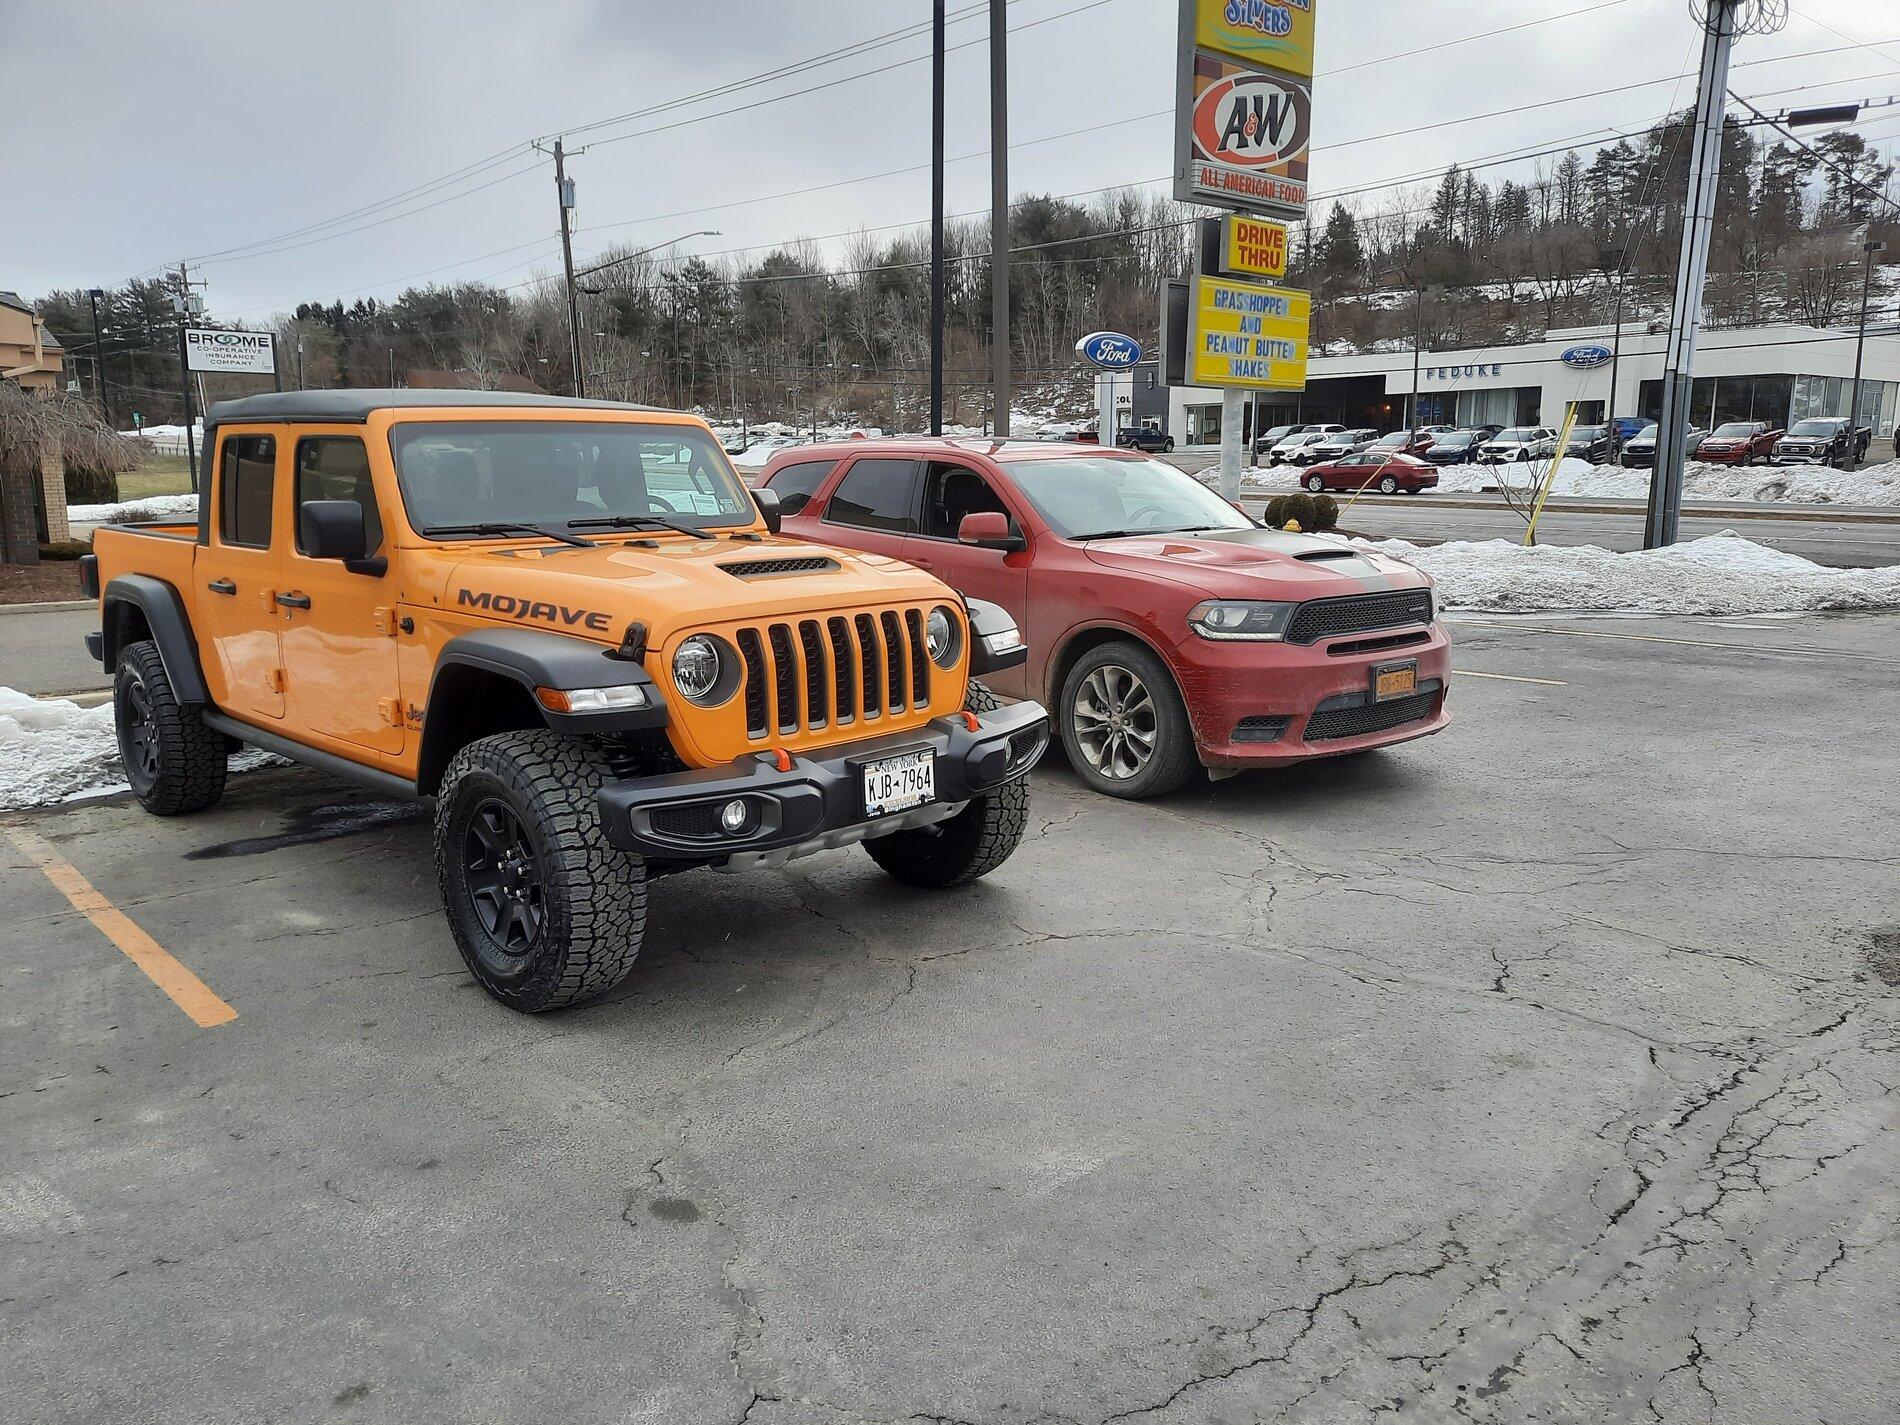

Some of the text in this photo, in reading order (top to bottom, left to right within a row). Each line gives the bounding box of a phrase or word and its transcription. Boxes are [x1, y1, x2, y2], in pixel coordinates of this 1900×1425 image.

[1215, 92, 1295, 153] A&W
[1200, 167, 1306, 204] ALL AMERICAN FOOD
[1237, 222, 1284, 249] DRIVE
[1238, 245, 1281, 270] THRU
[1240, 316, 1262, 335] AND
[196, 346, 263, 355] CO-OPERATIVE
[1096, 339, 1132, 363] Ford
[1206, 333, 1250, 355] PEANUT
[205, 352, 256, 361] INSURANCE
[1570, 348, 1601, 363] Ford
[1229, 359, 1270, 379] SHAKES
[1427, 364, 1502, 380] FEDUKE
[458, 588, 613, 632] MOJAVE
[881, 758, 918, 773] NEW YORK
